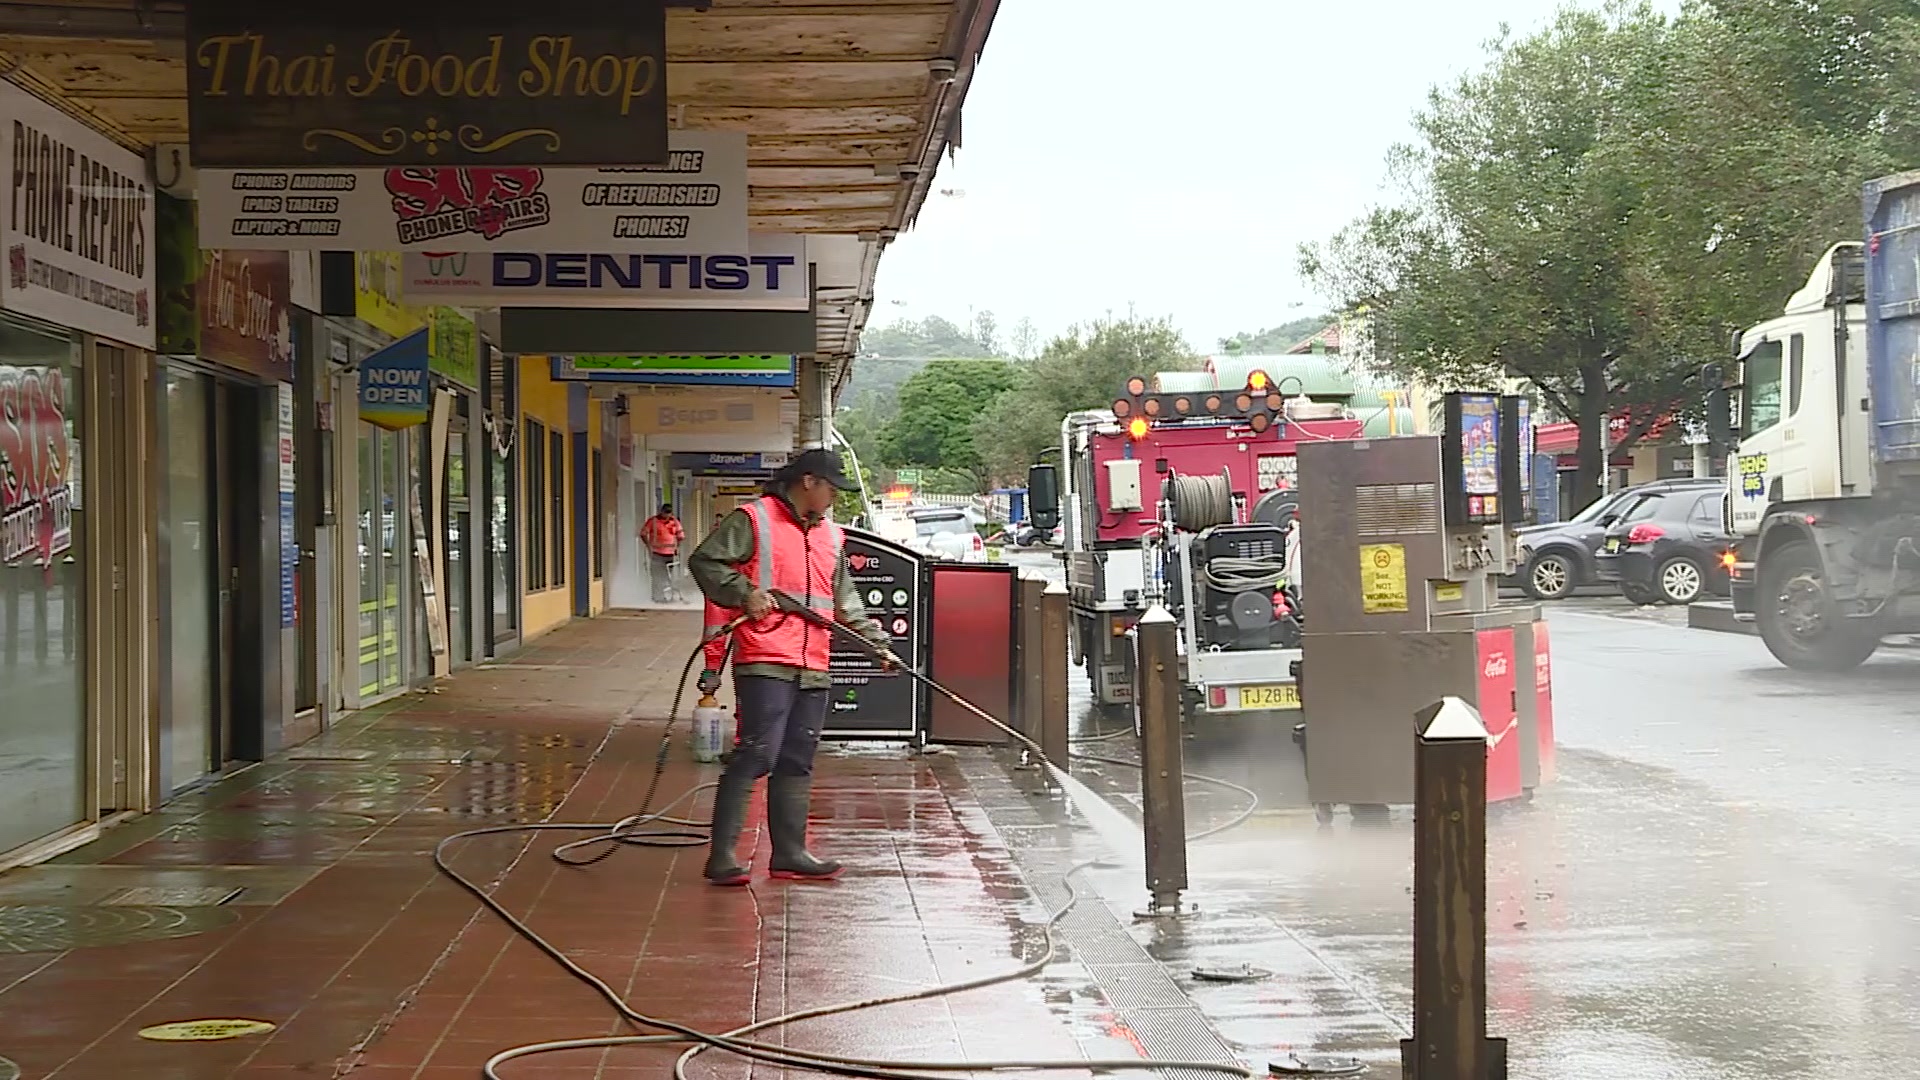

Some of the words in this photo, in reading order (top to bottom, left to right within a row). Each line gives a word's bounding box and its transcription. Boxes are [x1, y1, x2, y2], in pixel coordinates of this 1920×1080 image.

[197, 31, 336, 97] Thai
[347, 29, 503, 97] Food
[518, 35, 658, 116] Shop
[290, 174, 356, 191] ANDROIDS
[11, 119, 75, 253] PHONE
[78, 153, 146, 280] REPAIRS
[242, 196, 282, 213] IPADS
[286, 197, 339, 213] TABLETS
[583, 184, 606, 205] OF
[605, 184, 720, 206] REFURBISHED
[232, 219, 287, 235] LAPTOPS
[287, 222, 299, 235] &
[299, 219, 341, 235] MORE!
[400, 211, 465, 242] PHONE
[466, 197, 546, 229] REPAIRS
[614, 216, 689, 237] PHONES!
[493, 253, 794, 290] DENTIST
[368, 368, 422, 385] NOW
[365, 388, 423, 403] OPEN
[1366, 592, 1405, 600] WORKING
